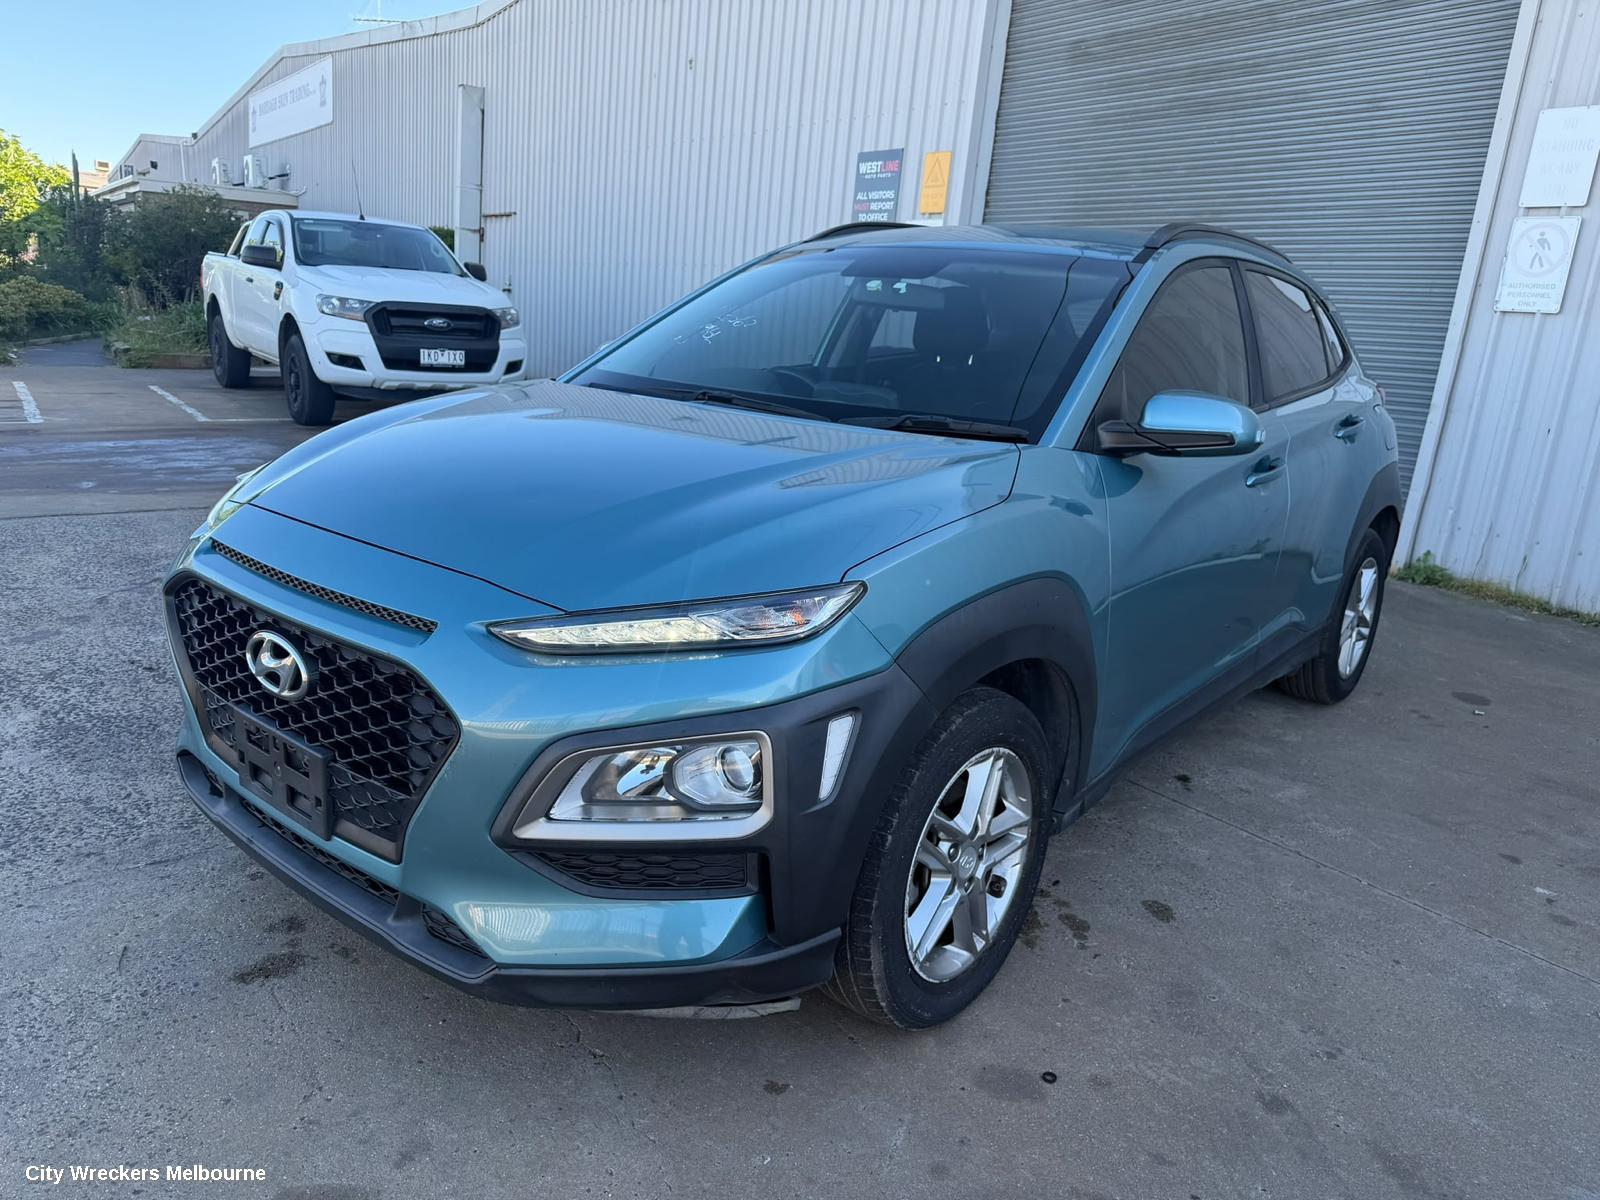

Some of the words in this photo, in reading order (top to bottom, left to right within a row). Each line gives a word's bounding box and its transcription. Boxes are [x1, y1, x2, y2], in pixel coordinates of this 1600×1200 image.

[859, 160, 899, 174] WESTLINE
[856, 191, 868, 200] ALL
[868, 190, 895, 200] VISITORS
[870, 201, 894, 210] REPORT
[858, 213, 866, 222] TO
[867, 213, 888, 221] OFFICE
